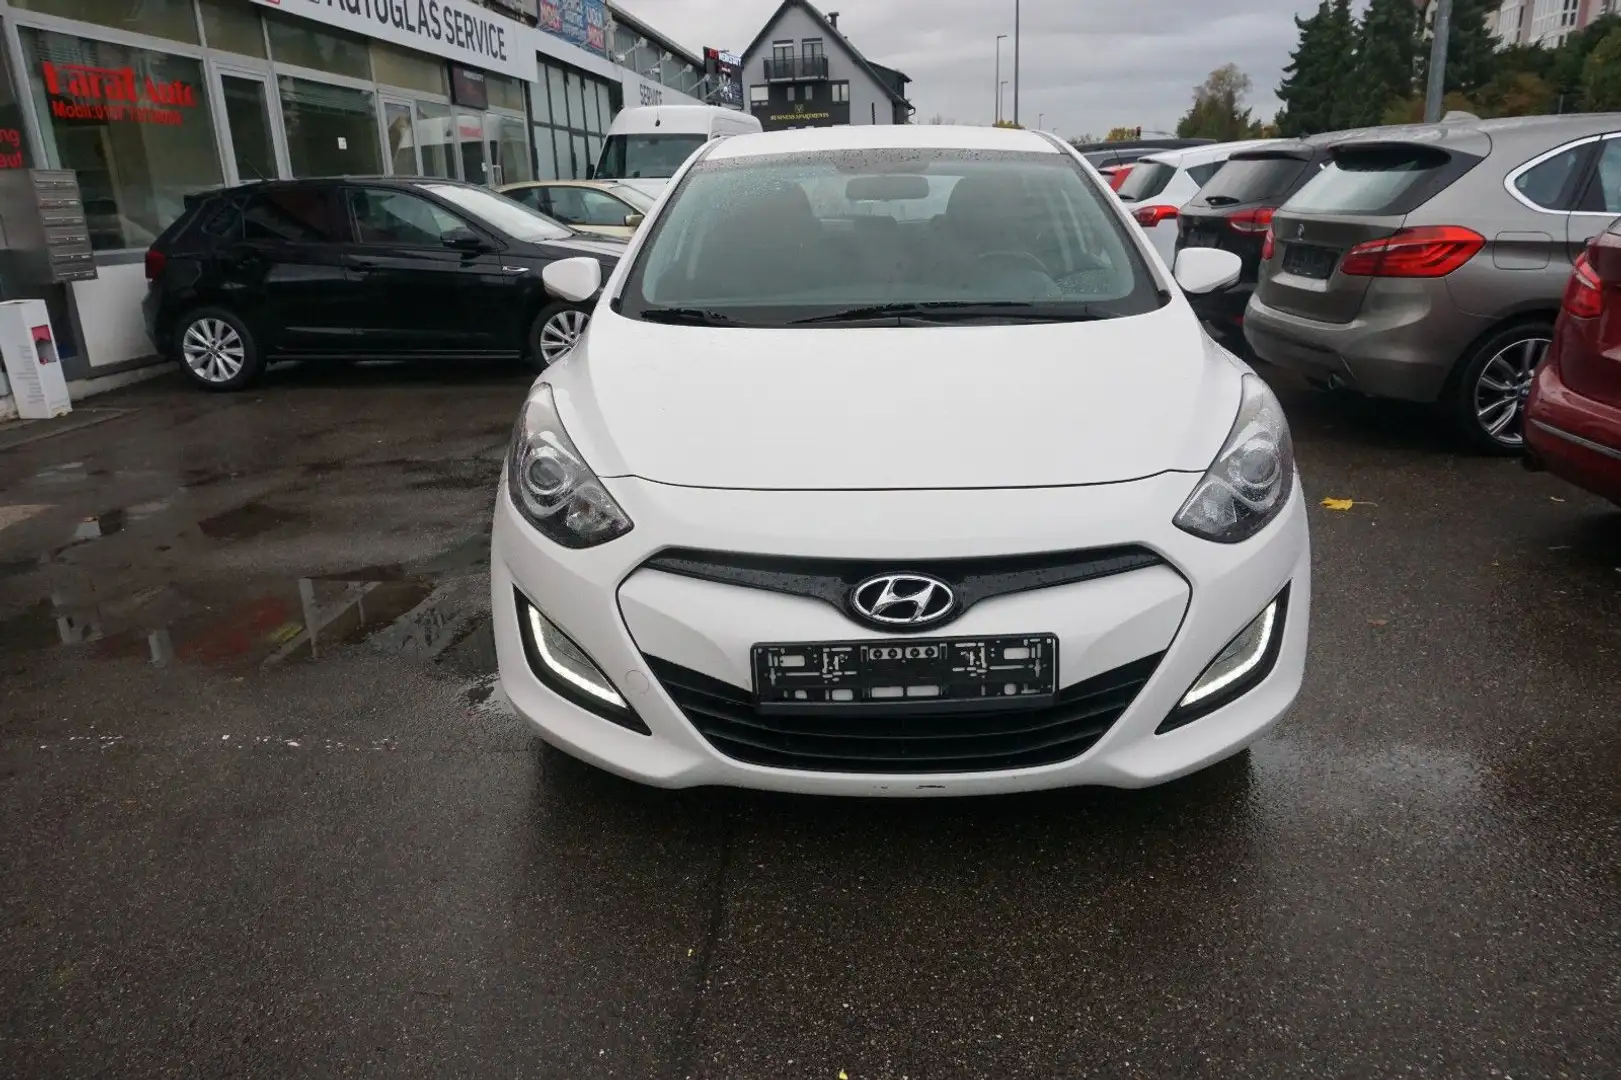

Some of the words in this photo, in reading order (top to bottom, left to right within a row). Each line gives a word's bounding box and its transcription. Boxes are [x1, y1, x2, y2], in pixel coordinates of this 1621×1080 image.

[327, 0, 442, 40] OGLAS
[443, 5, 507, 61] SERVICE
[639, 83, 663, 106] SERVICE
[796, 112, 829, 120] APARTMENTS
